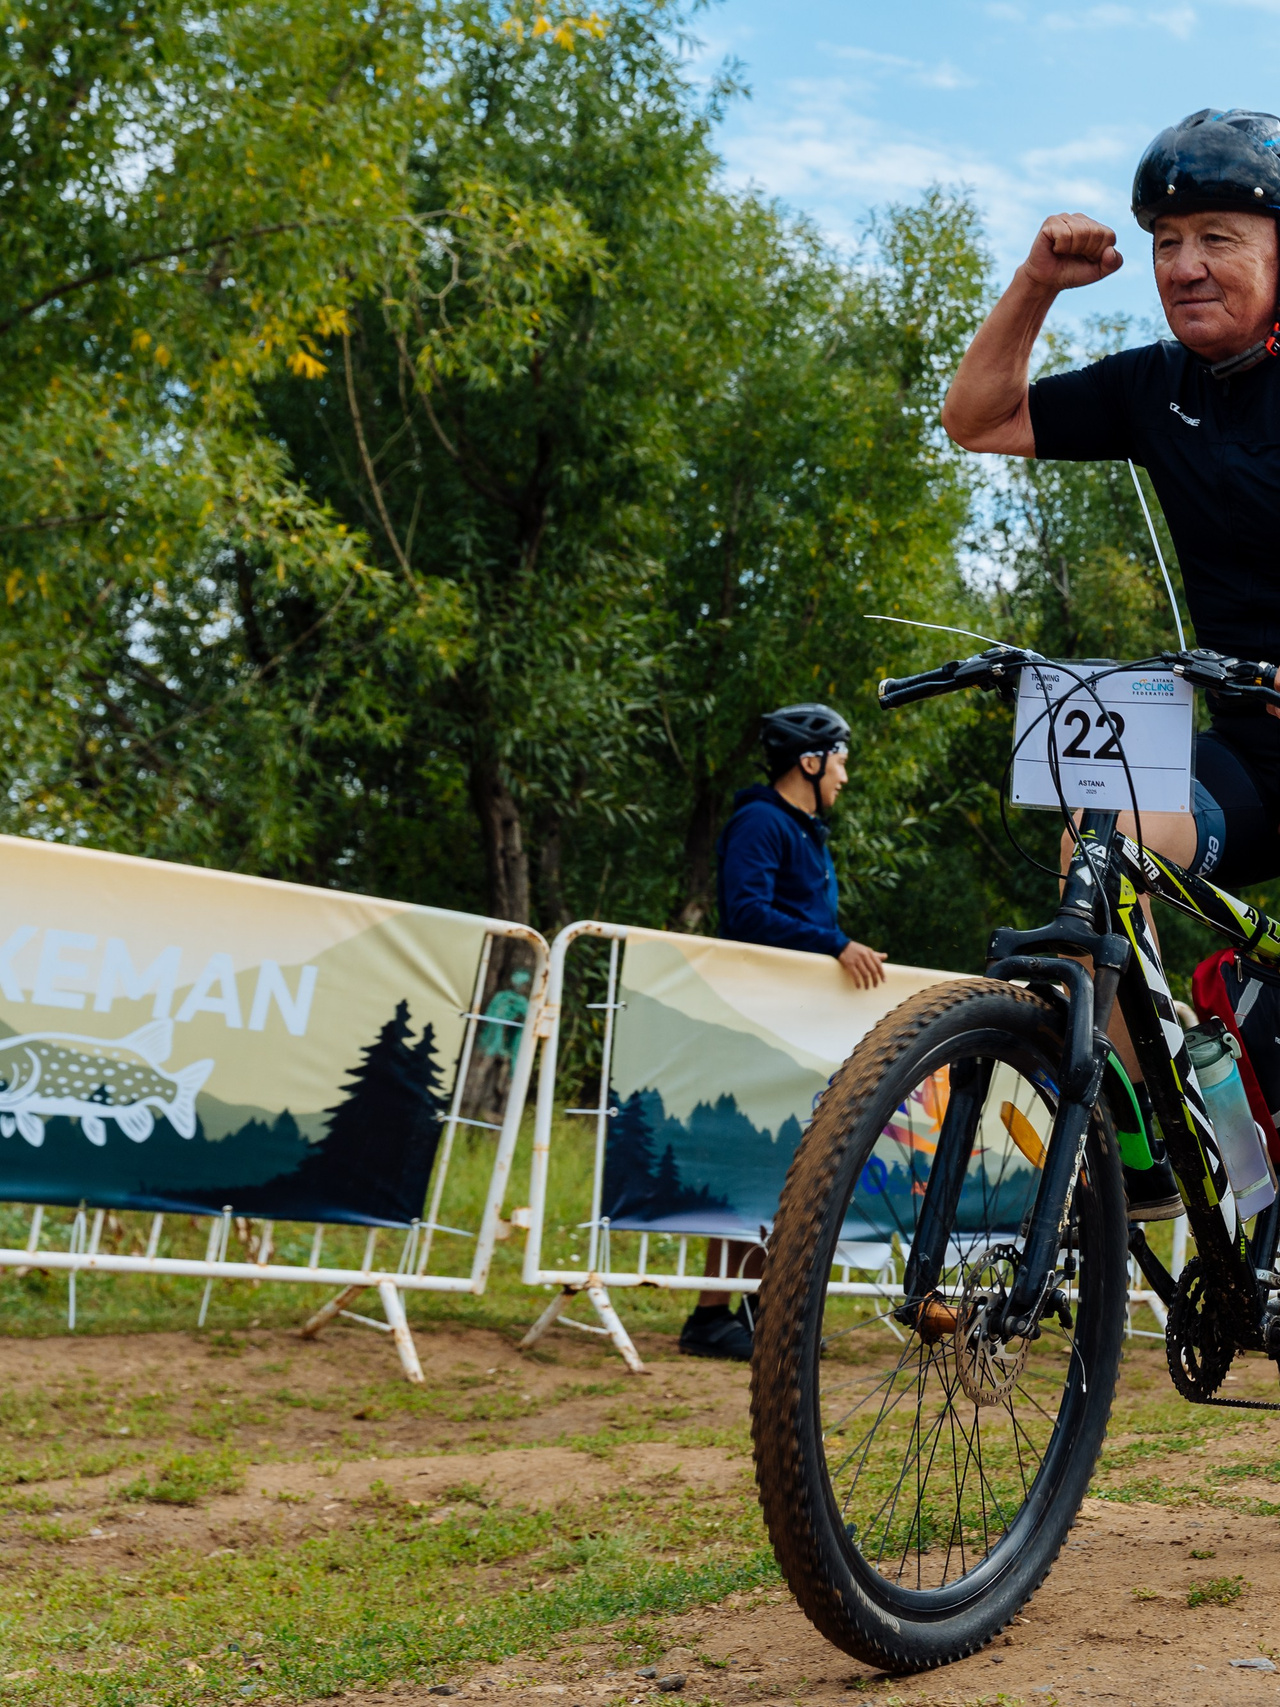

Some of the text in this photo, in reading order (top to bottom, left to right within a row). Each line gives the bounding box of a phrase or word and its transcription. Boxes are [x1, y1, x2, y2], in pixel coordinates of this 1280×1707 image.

[1132, 682, 1174, 692] CYCLING
[1062, 709, 1125, 760] 22
[1078, 779, 1106, 788] ASTANA
